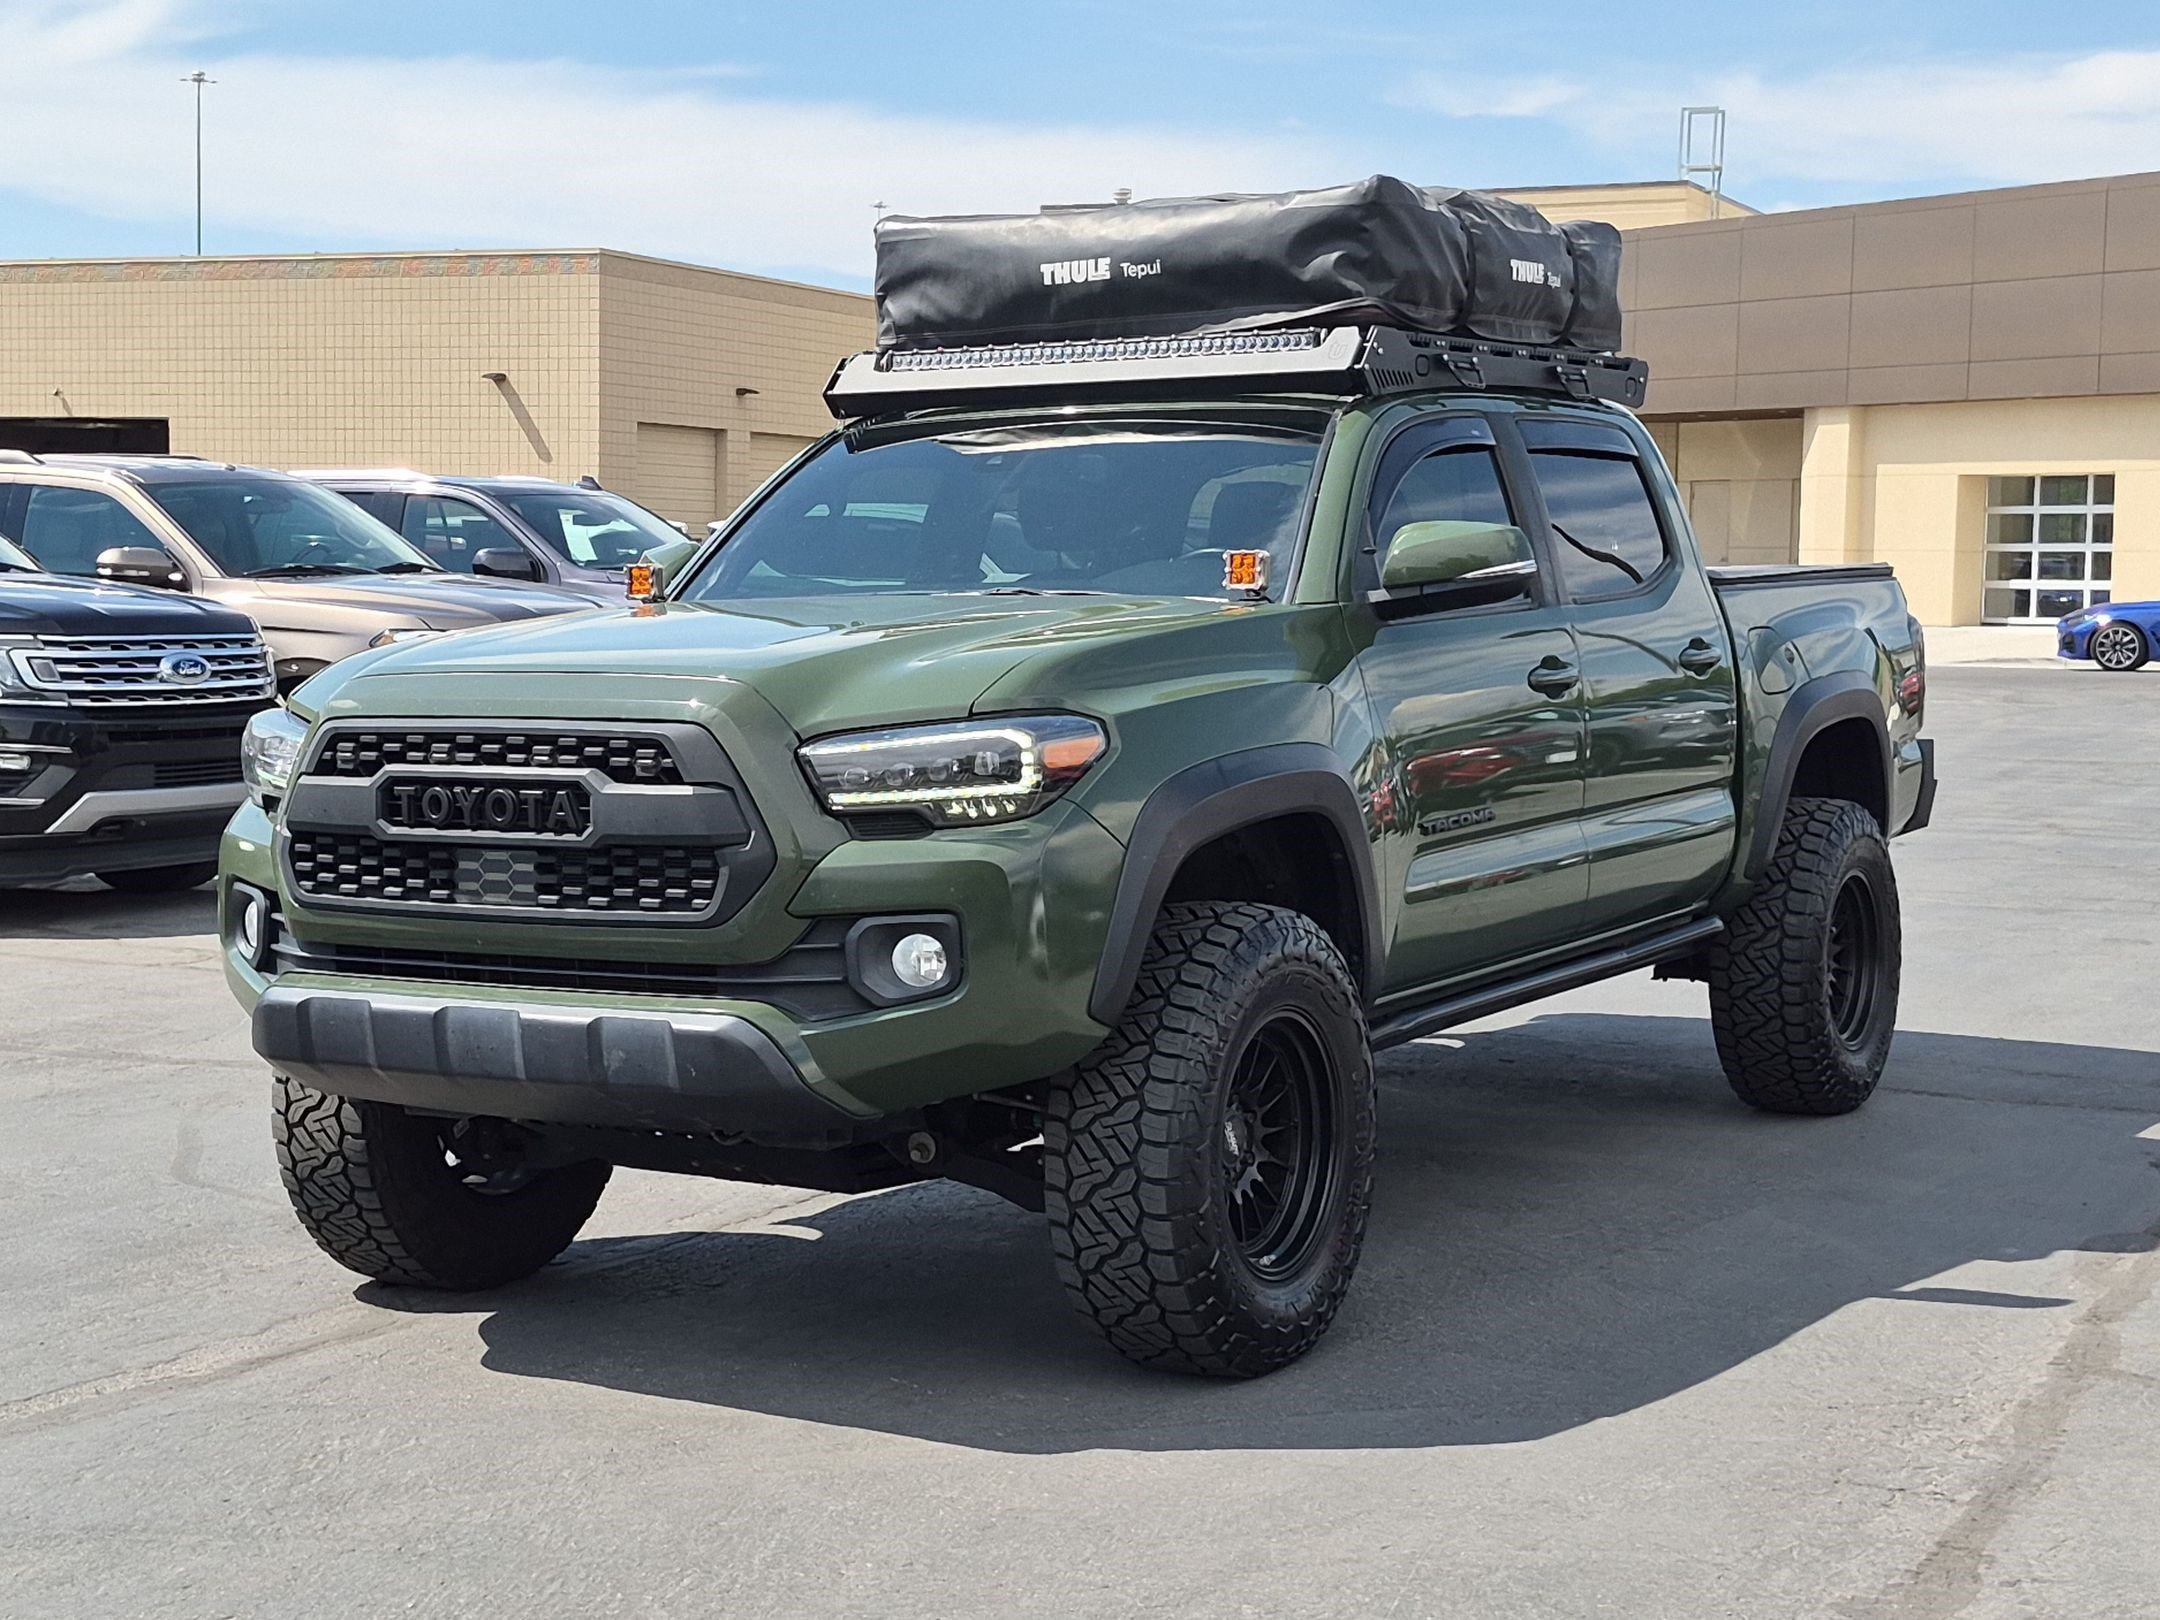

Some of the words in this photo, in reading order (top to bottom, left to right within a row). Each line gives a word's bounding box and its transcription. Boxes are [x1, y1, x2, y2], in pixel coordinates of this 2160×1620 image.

[1040, 257, 1111, 286] THULE
[1120, 259, 1161, 279] Tepui
[1510, 258, 1545, 285] THULE
[393, 786, 581, 832] TOYOTA
[1419, 806, 1497, 836] TACOMA
